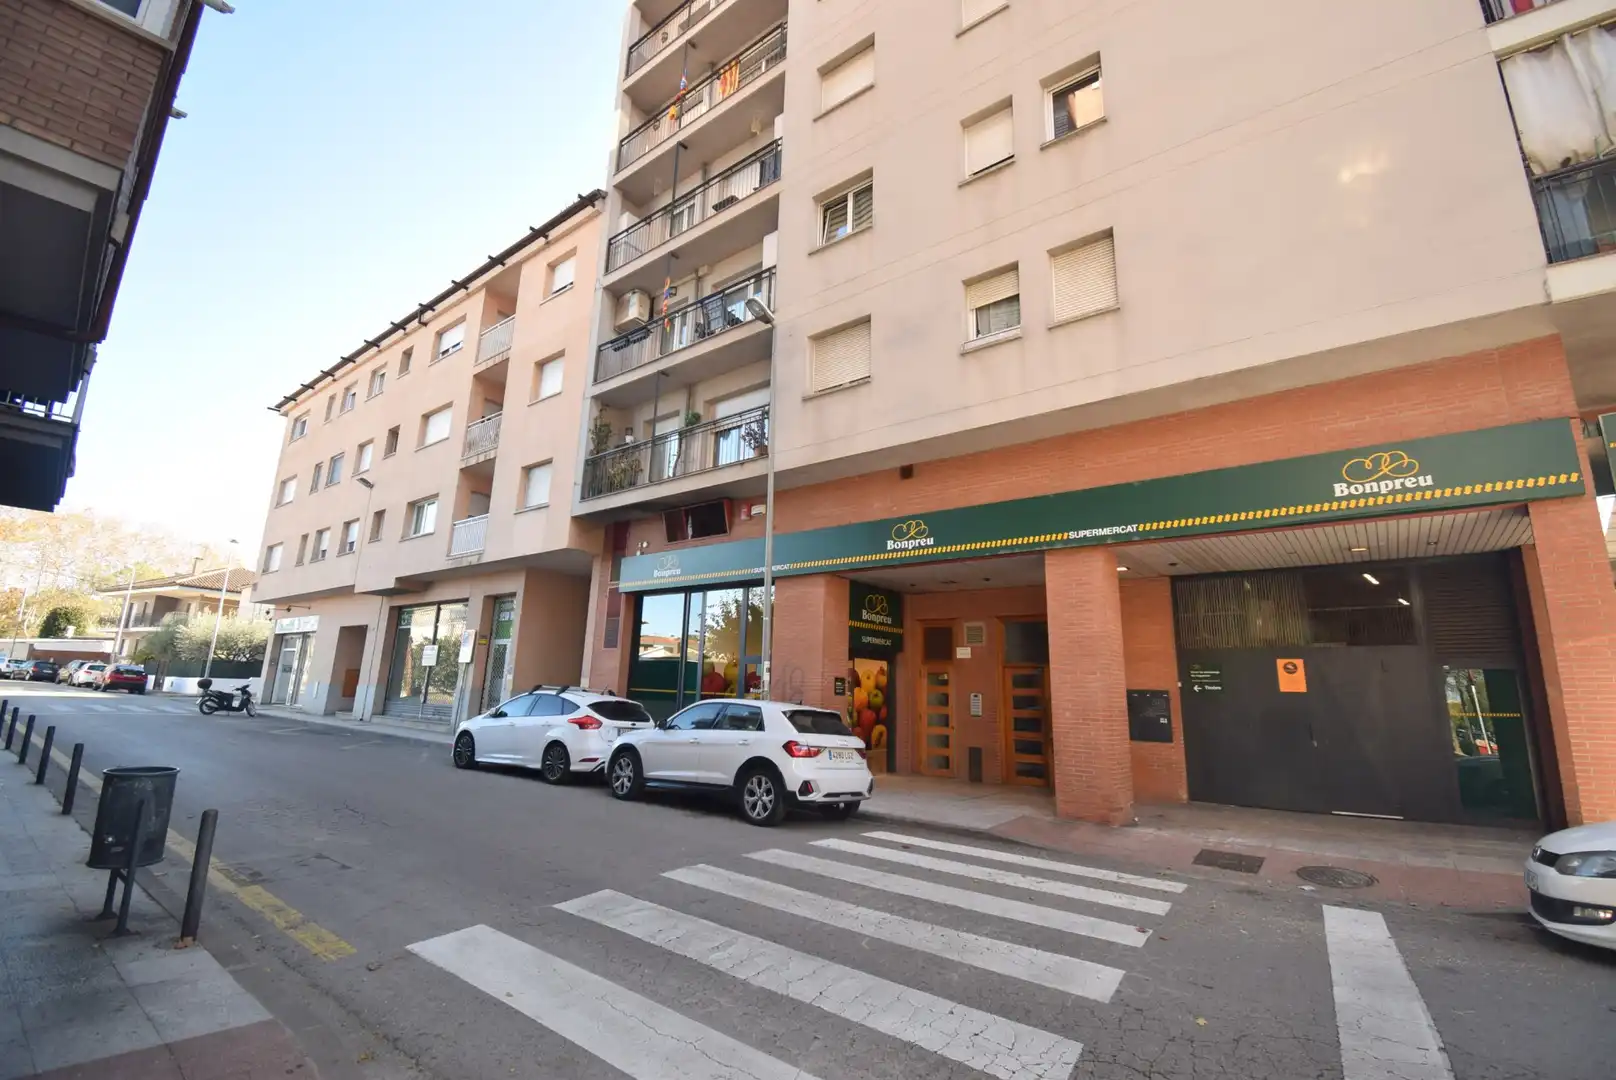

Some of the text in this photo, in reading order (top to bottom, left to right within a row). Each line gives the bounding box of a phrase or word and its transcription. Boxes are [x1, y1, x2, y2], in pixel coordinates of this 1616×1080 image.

[1333, 475, 1433, 497] Bonpreu
[1068, 524, 1138, 539] SUPERMERCAT
[886, 537, 934, 550] Bonpreu
[653, 568, 681, 578] Bonpreu
[862, 609, 892, 625] Bonpreu
[861, 635, 892, 646] SUPERMERCAT
